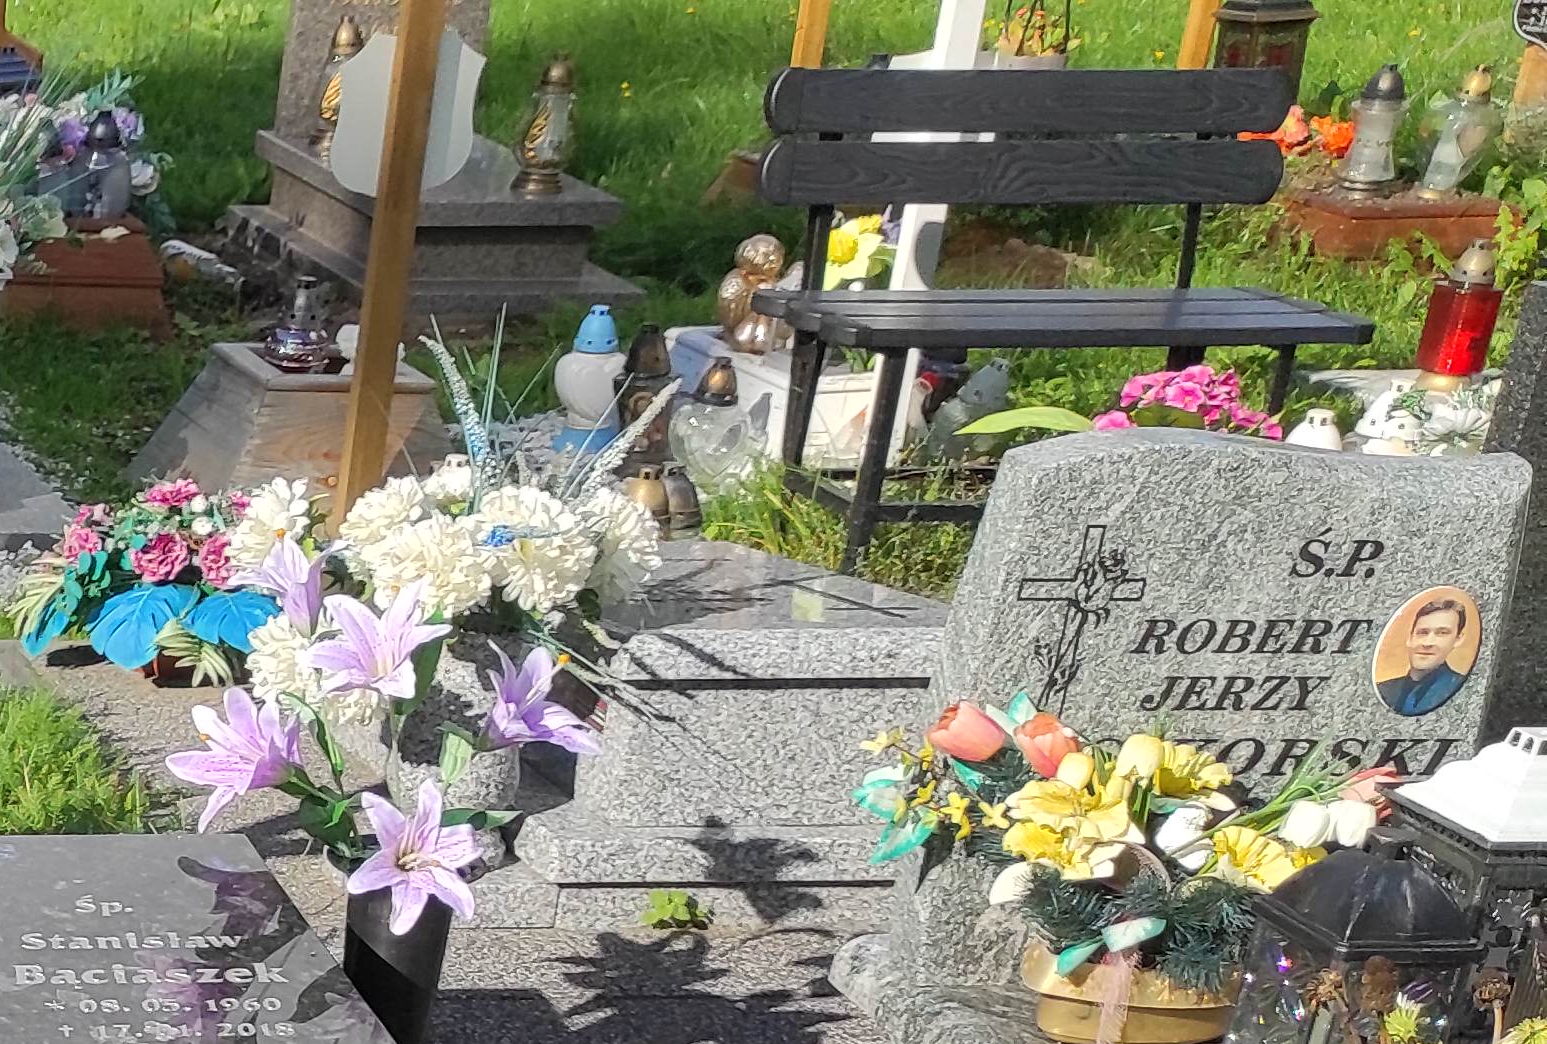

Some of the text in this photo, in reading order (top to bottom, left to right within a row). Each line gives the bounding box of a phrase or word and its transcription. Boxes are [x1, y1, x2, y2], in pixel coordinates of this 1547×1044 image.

[1289, 527, 1384, 579] Ś.P.
[1130, 618, 1373, 654] ROBERT
[1140, 675, 1332, 711] JERZY
[74, 894, 134, 917] Śp.
[20, 931, 242, 951] Stanisław
[12, 962, 290, 990] Bąciaszek
[79, 997, 282, 1013] 08. 05. 1960
[216, 1022, 295, 1038] 2018
